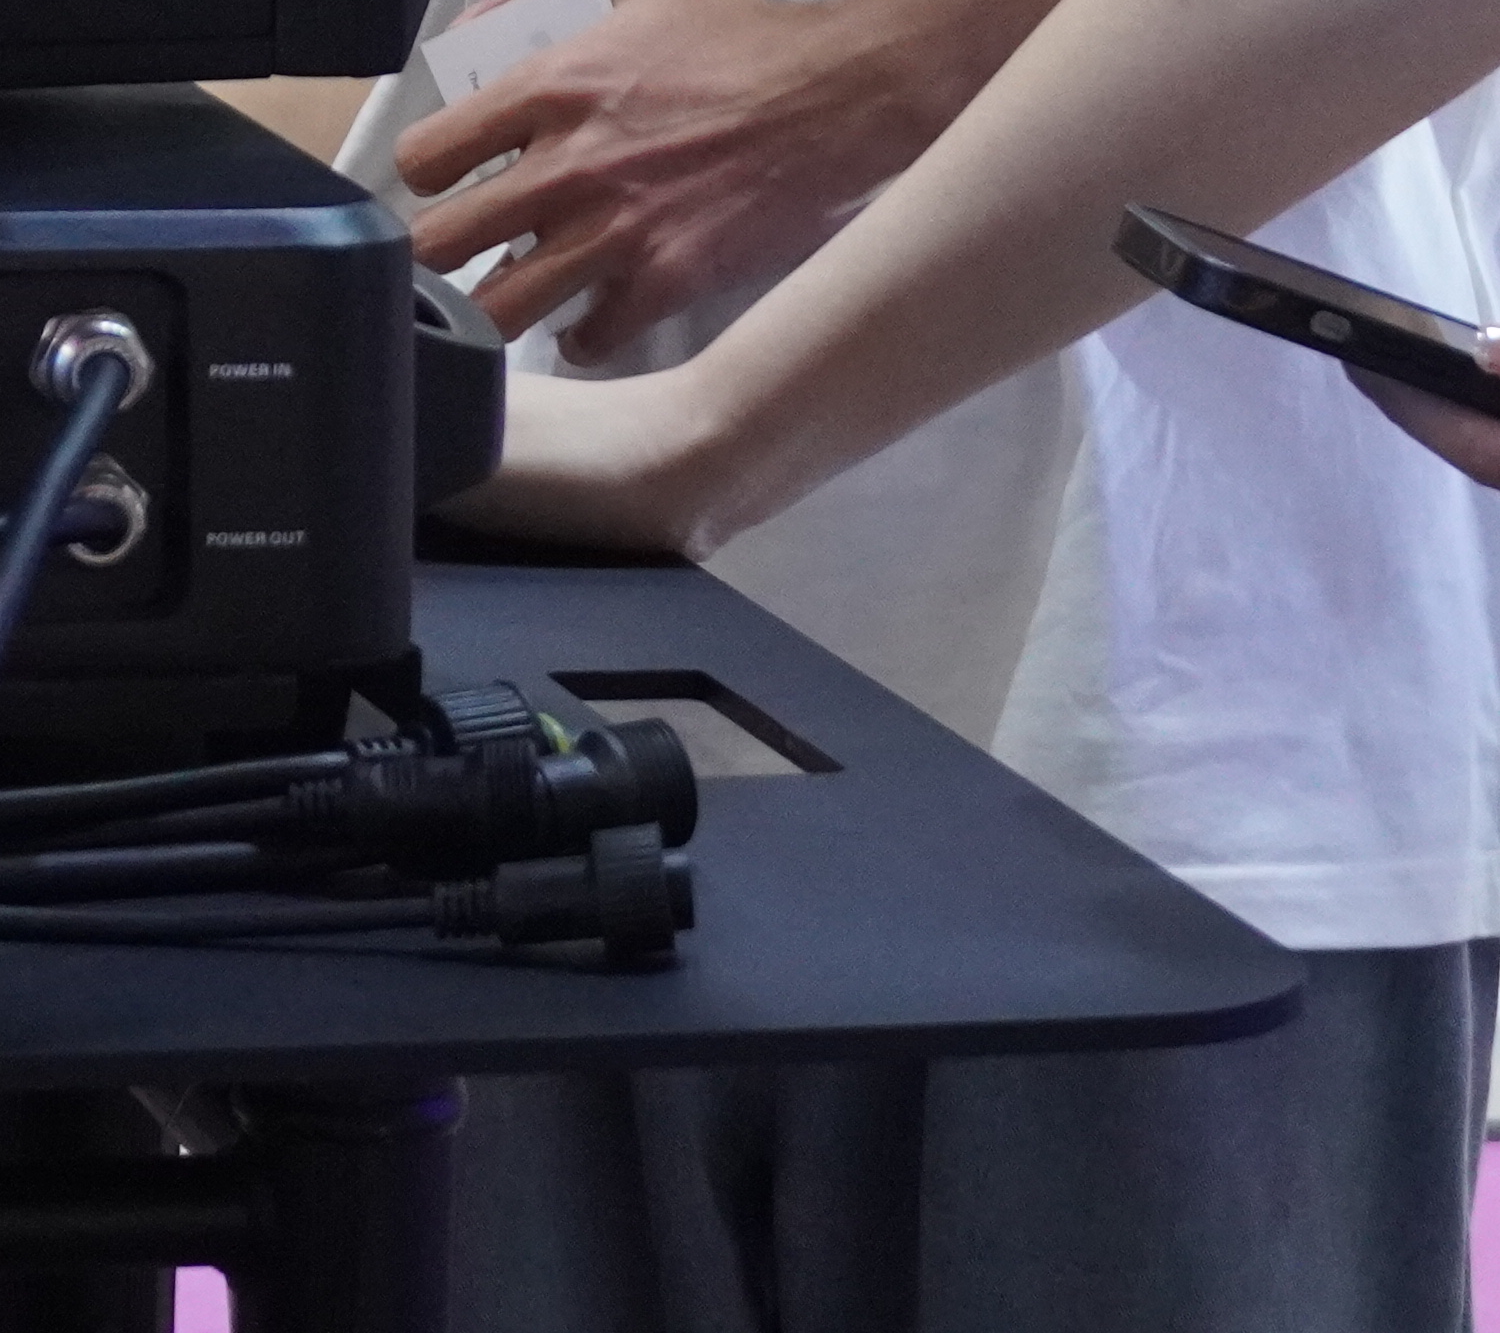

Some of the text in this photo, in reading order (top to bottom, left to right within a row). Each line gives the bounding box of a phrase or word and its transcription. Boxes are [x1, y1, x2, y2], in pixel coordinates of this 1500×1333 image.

[208, 362, 292, 378] POWER IN
[205, 530, 305, 546] POWER OUT
